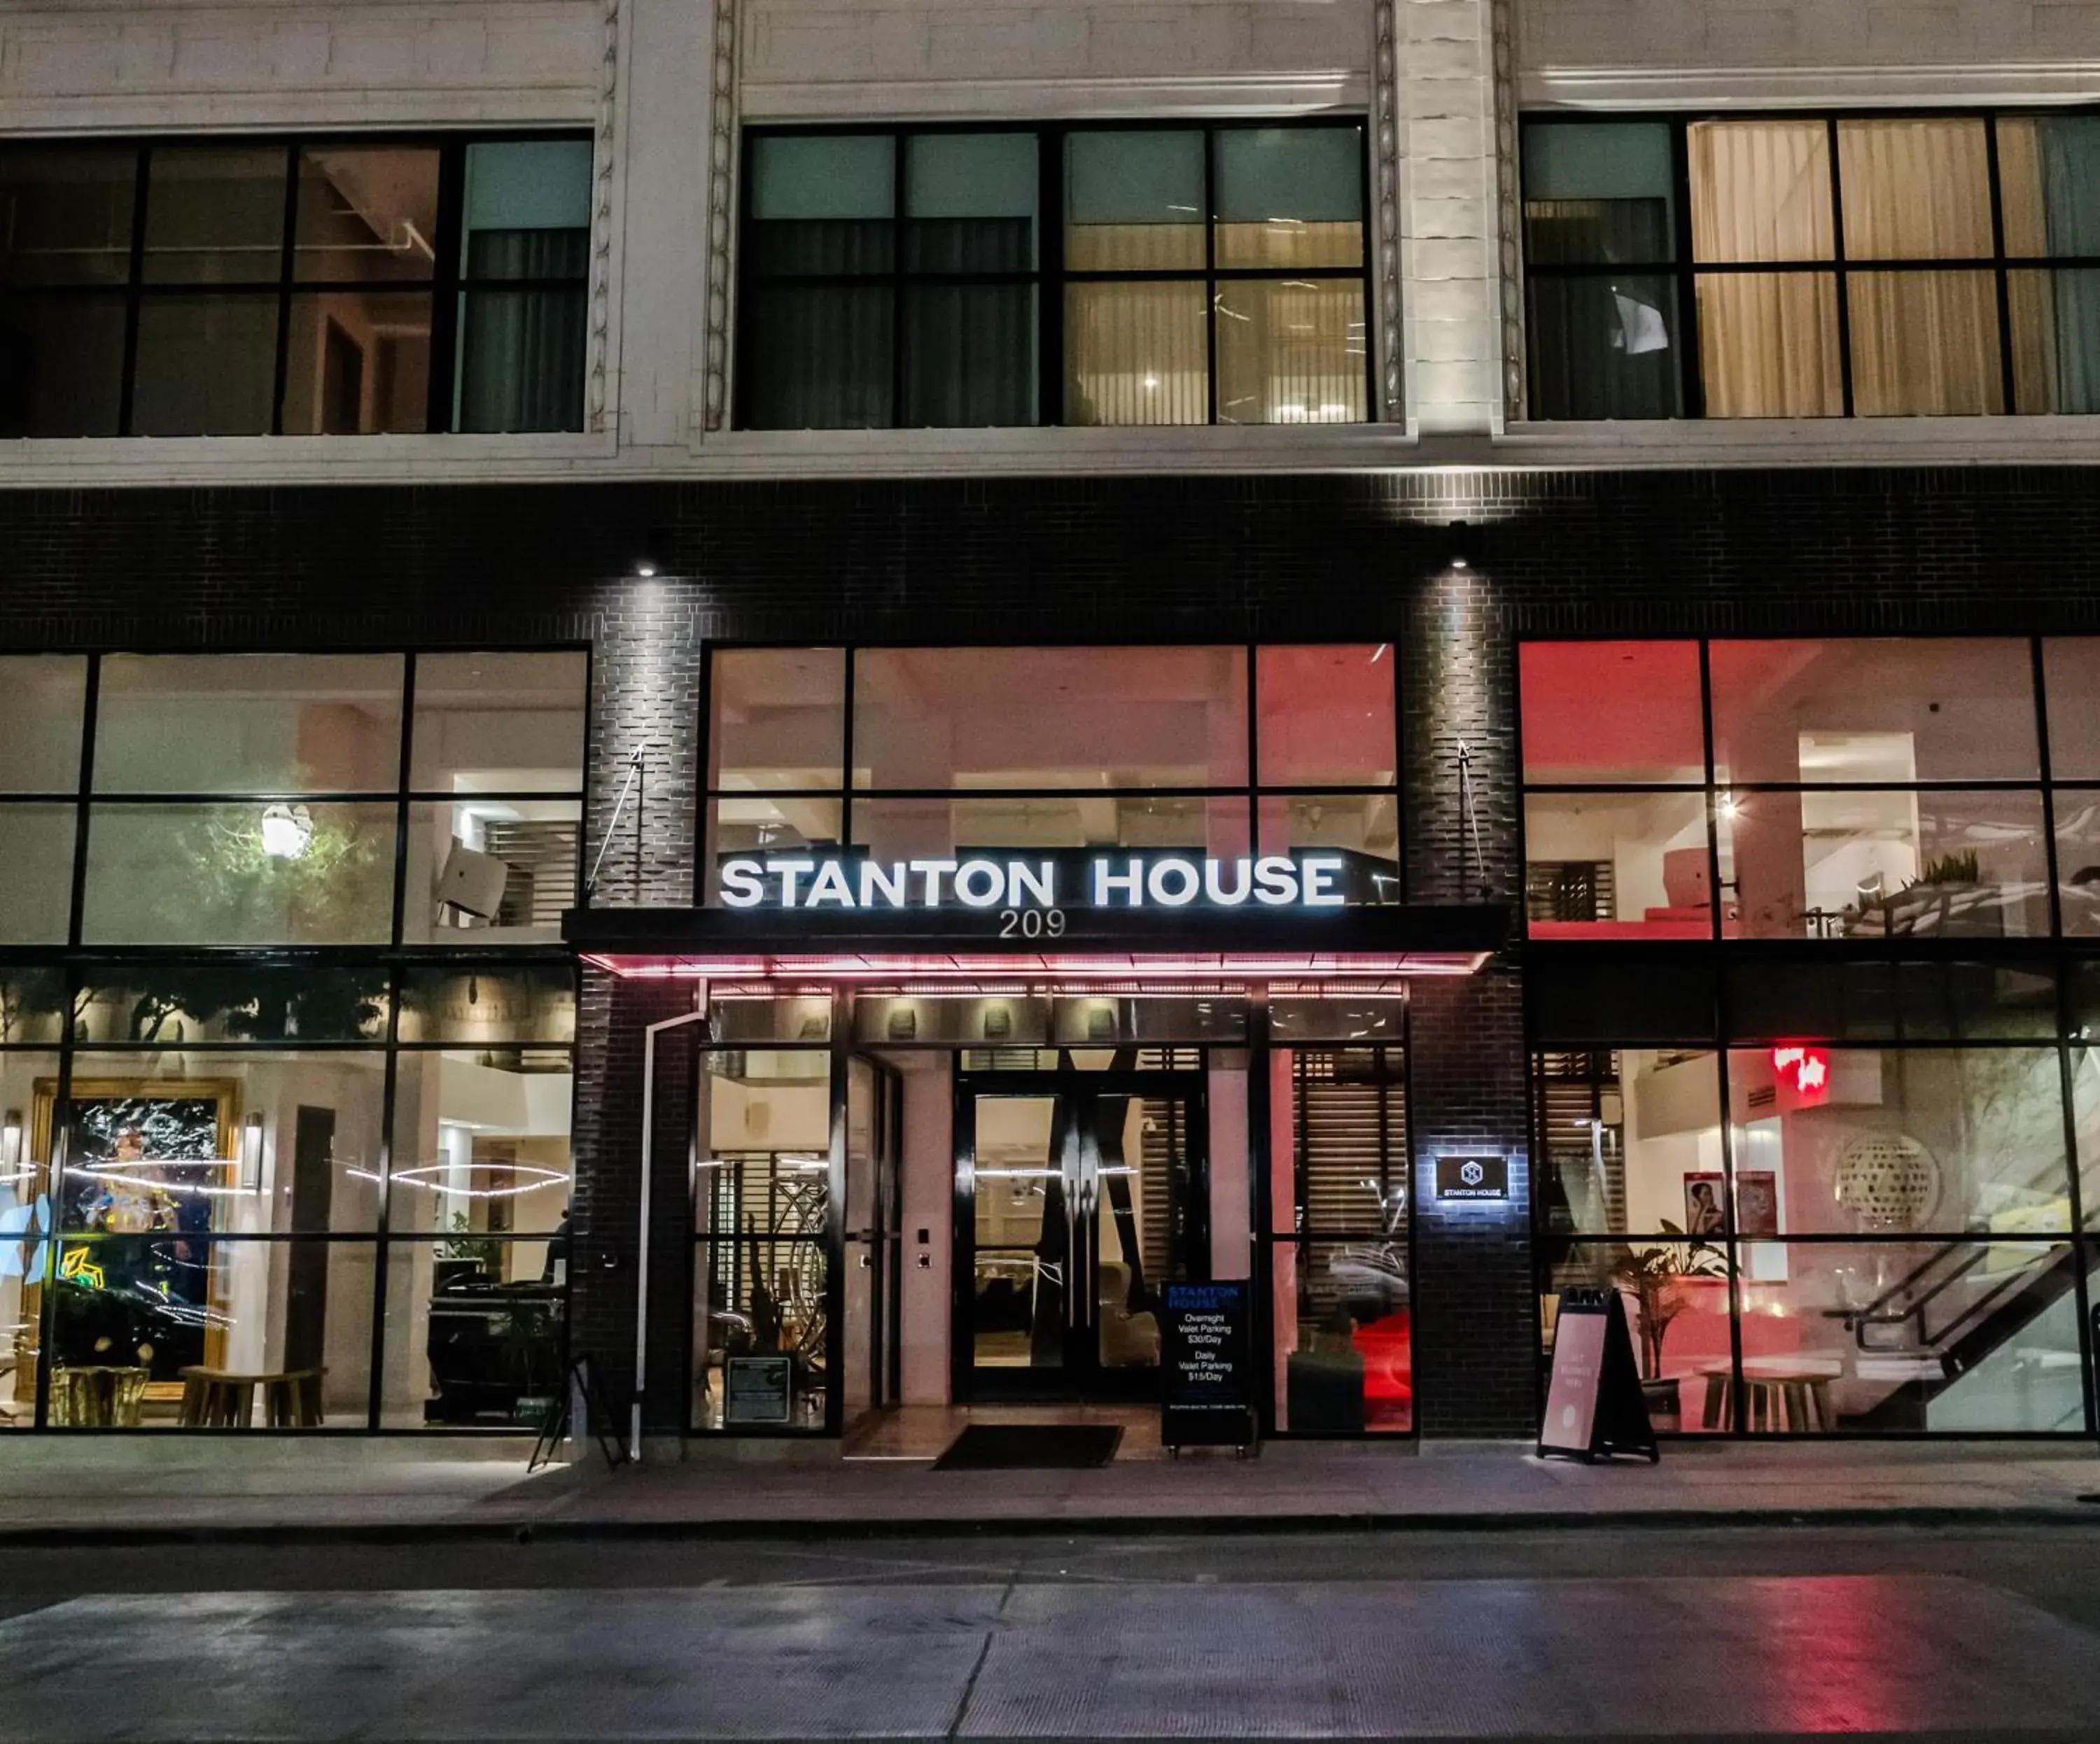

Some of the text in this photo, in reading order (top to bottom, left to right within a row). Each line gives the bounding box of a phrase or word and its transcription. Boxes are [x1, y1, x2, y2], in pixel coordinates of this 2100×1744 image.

[720, 857, 1345, 908] STANTON HOUSE
[999, 910, 1066, 938] 209
[1168, 1286, 1238, 1297] STANTON
[1168, 1298, 1219, 1309] HOUSE
[1184, 1314, 1224, 1324] Overnight
[1178, 1325, 1231, 1335] Valet Parking
[1187, 1335, 1222, 1345] $30/Day
[1195, 1351, 1216, 1360] Daily
[1178, 1361, 1233, 1372] Valet Parking
[1188, 1372, 1224, 1381] $15/Day
